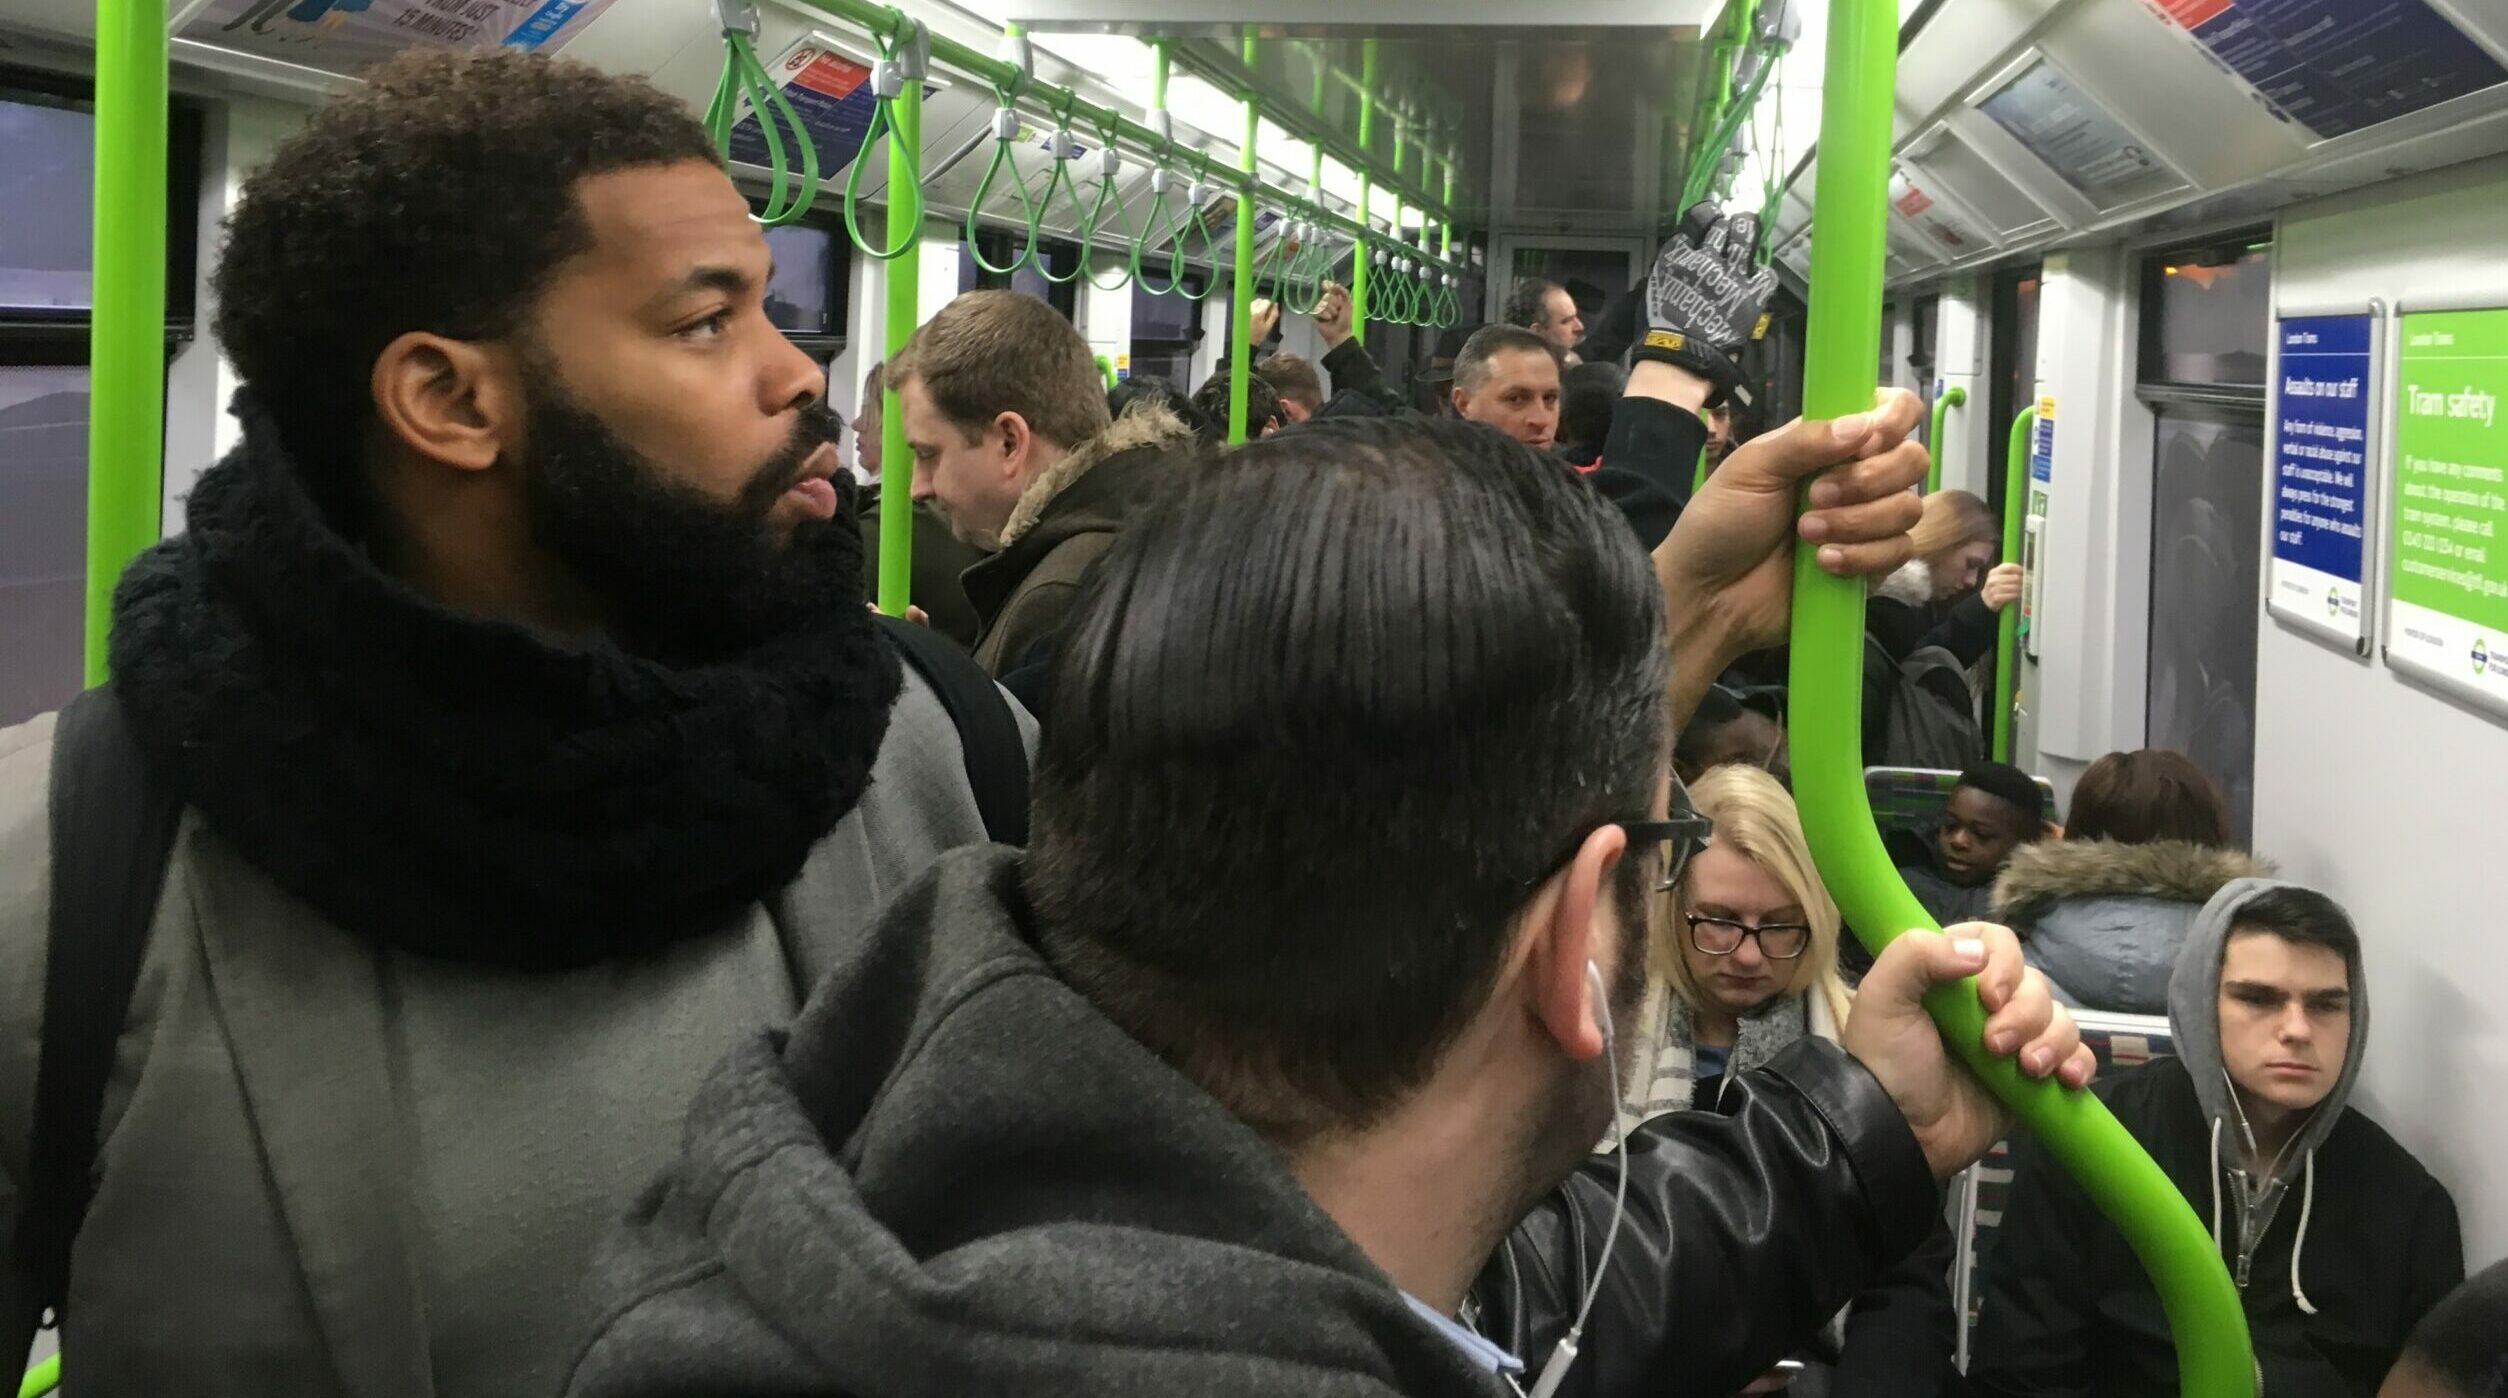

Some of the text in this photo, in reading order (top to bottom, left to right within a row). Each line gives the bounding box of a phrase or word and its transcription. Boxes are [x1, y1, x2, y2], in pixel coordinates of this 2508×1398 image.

[392, 8, 421, 27] 15
[460, 0, 500, 22] JUST
[1664, 236, 1748, 318] Mechanix
[1659, 273, 1741, 348] Mechanix
[2285, 377, 2359, 398] Assaults on our staff
[2408, 384, 2496, 428] Tram safety
[2404, 454, 2504, 482] If you have any comments
[2404, 482, 2506, 511] about the operation of the
[2403, 506, 2422, 522] tram
[2452, 515, 2478, 534] please
[2478, 519, 2494, 538] call
[2454, 544, 2464, 558] or
[2464, 546, 2487, 564] email
